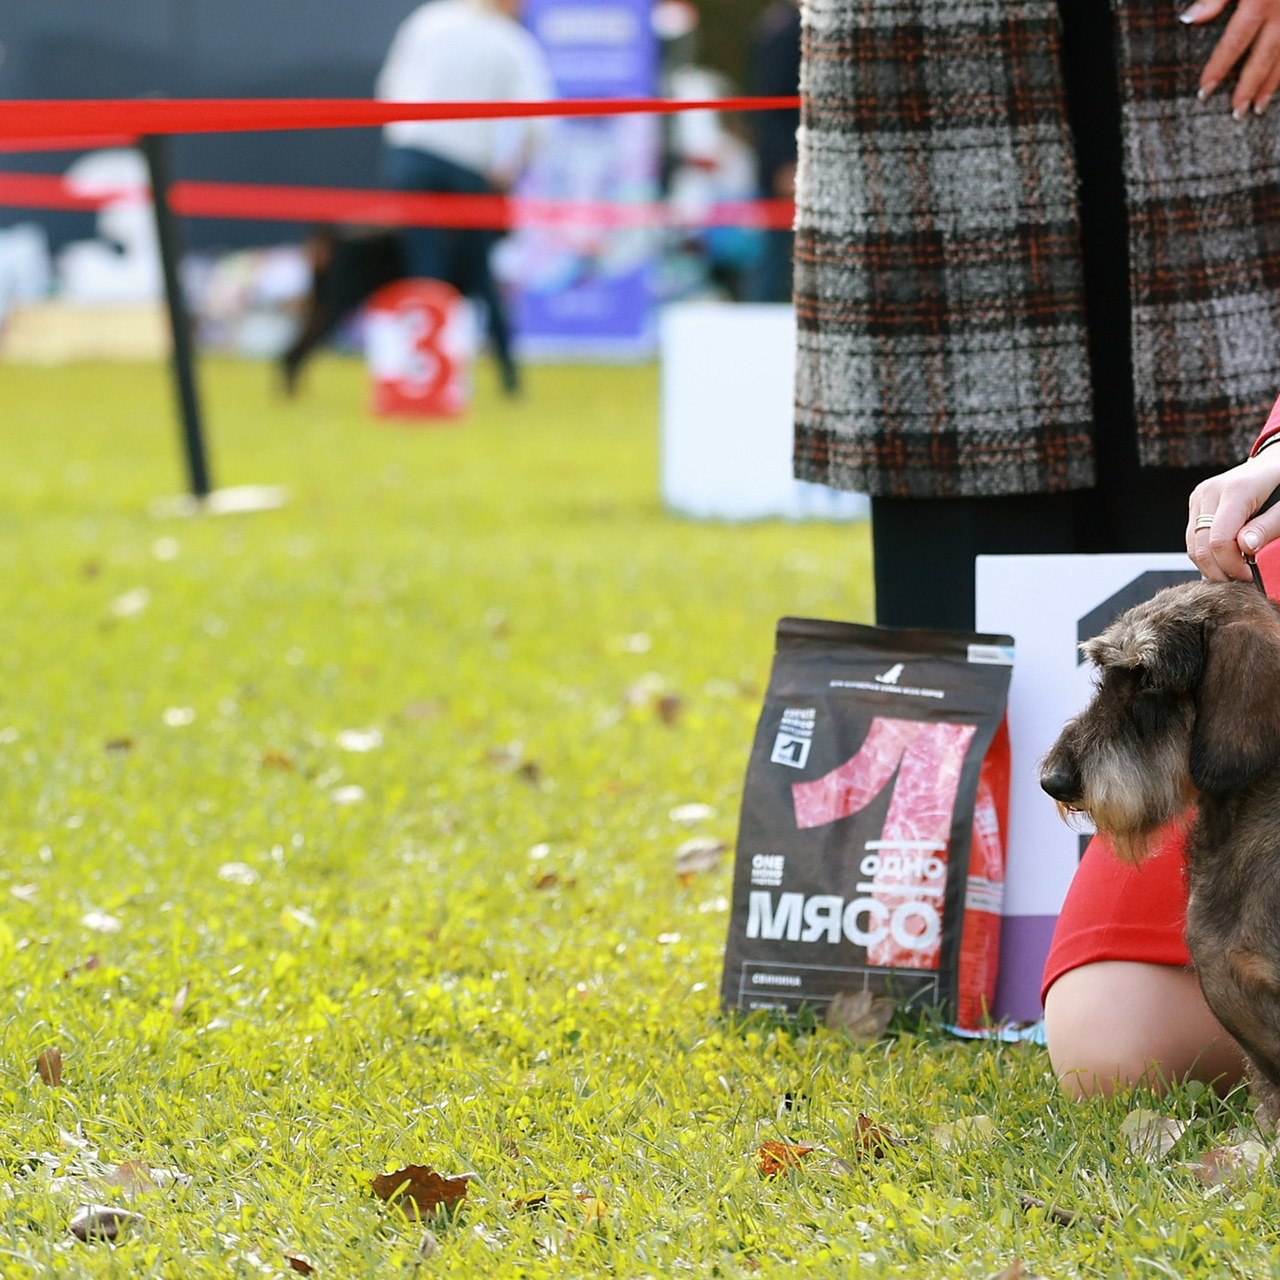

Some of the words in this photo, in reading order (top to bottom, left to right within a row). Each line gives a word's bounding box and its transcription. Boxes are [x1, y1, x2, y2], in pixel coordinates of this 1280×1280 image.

[392, 295, 453, 403] 3
[752, 853, 785, 869] ONE
[860, 854, 945, 879] ОДНО
[746, 890, 941, 950] МЯСО
